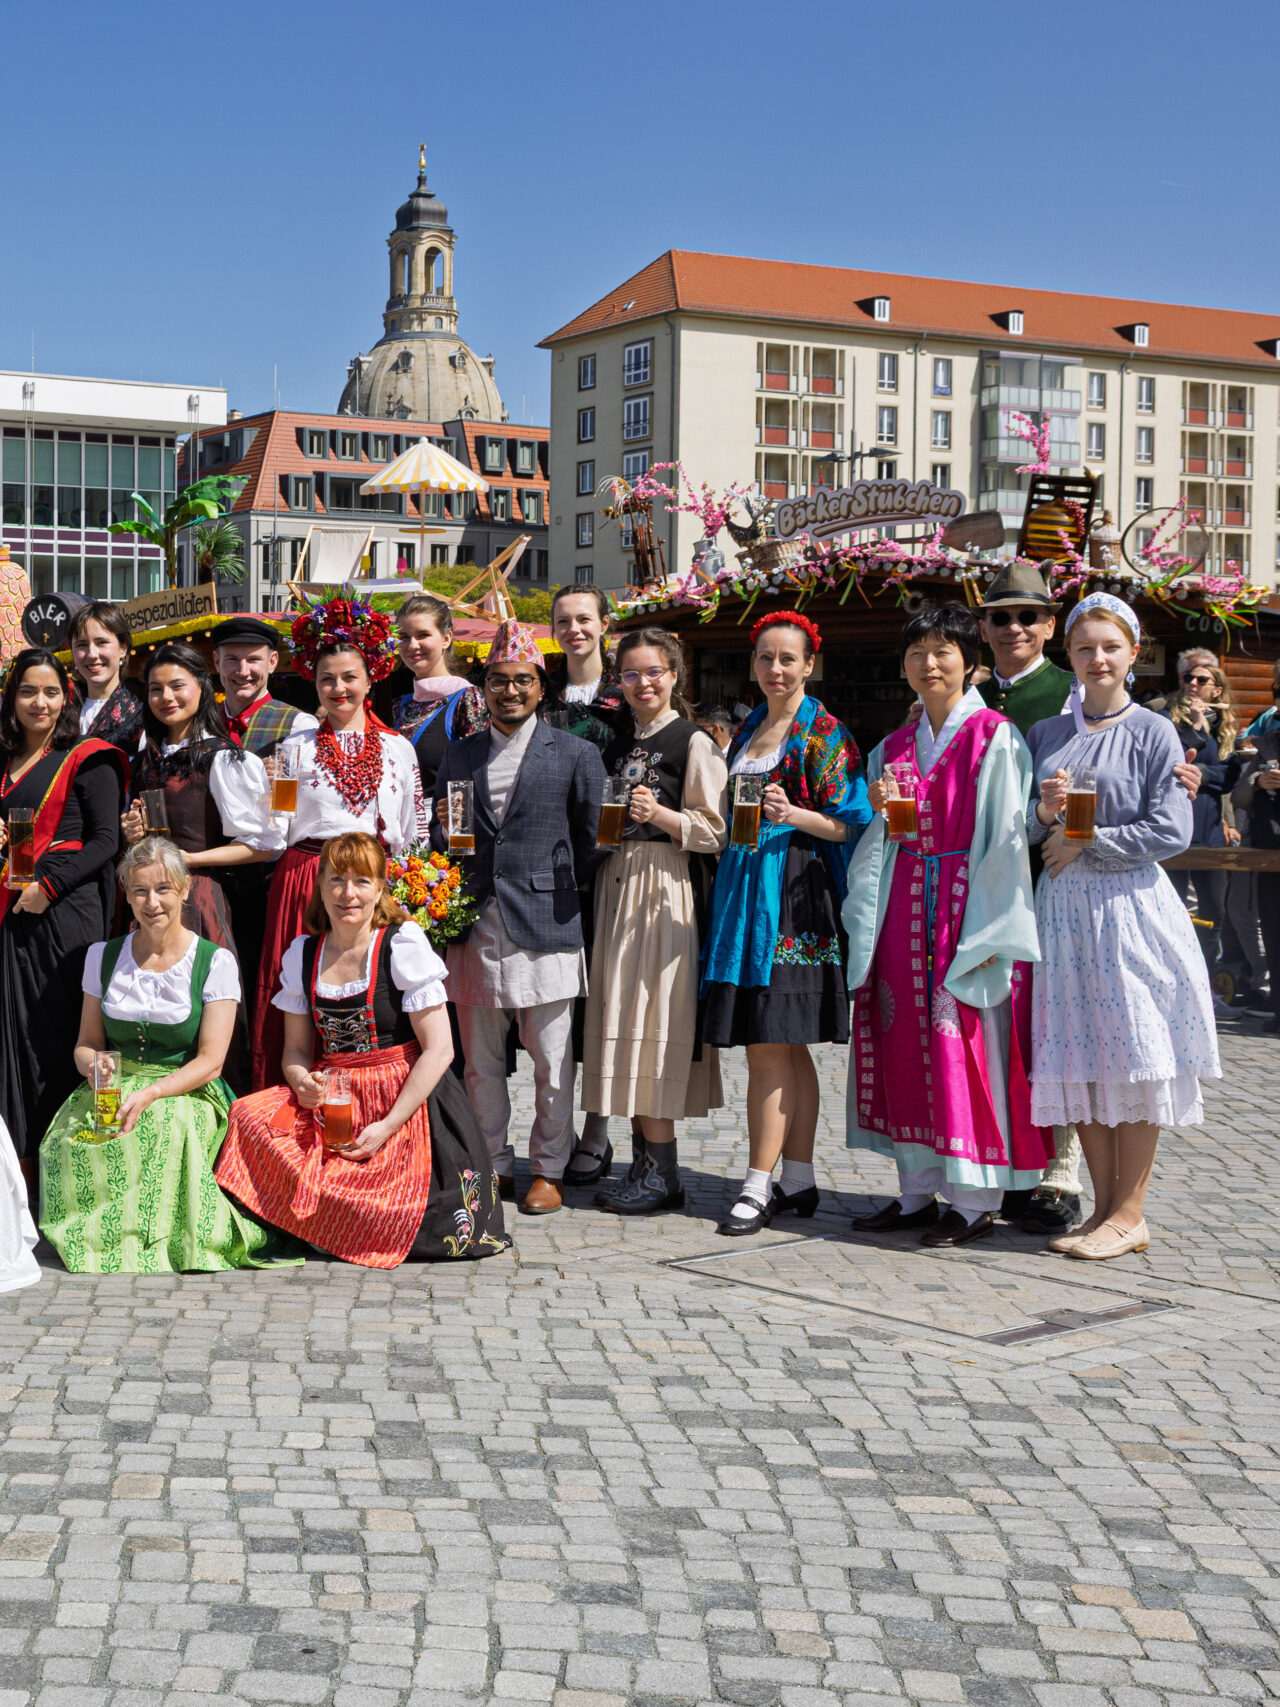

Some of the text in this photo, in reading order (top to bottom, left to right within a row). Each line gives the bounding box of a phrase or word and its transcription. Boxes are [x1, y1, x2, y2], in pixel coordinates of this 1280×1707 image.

[778, 483, 962, 537] BäckerStübchen
[29, 603, 67, 626] BIER
[122, 591, 213, 630] kespezialitäten
